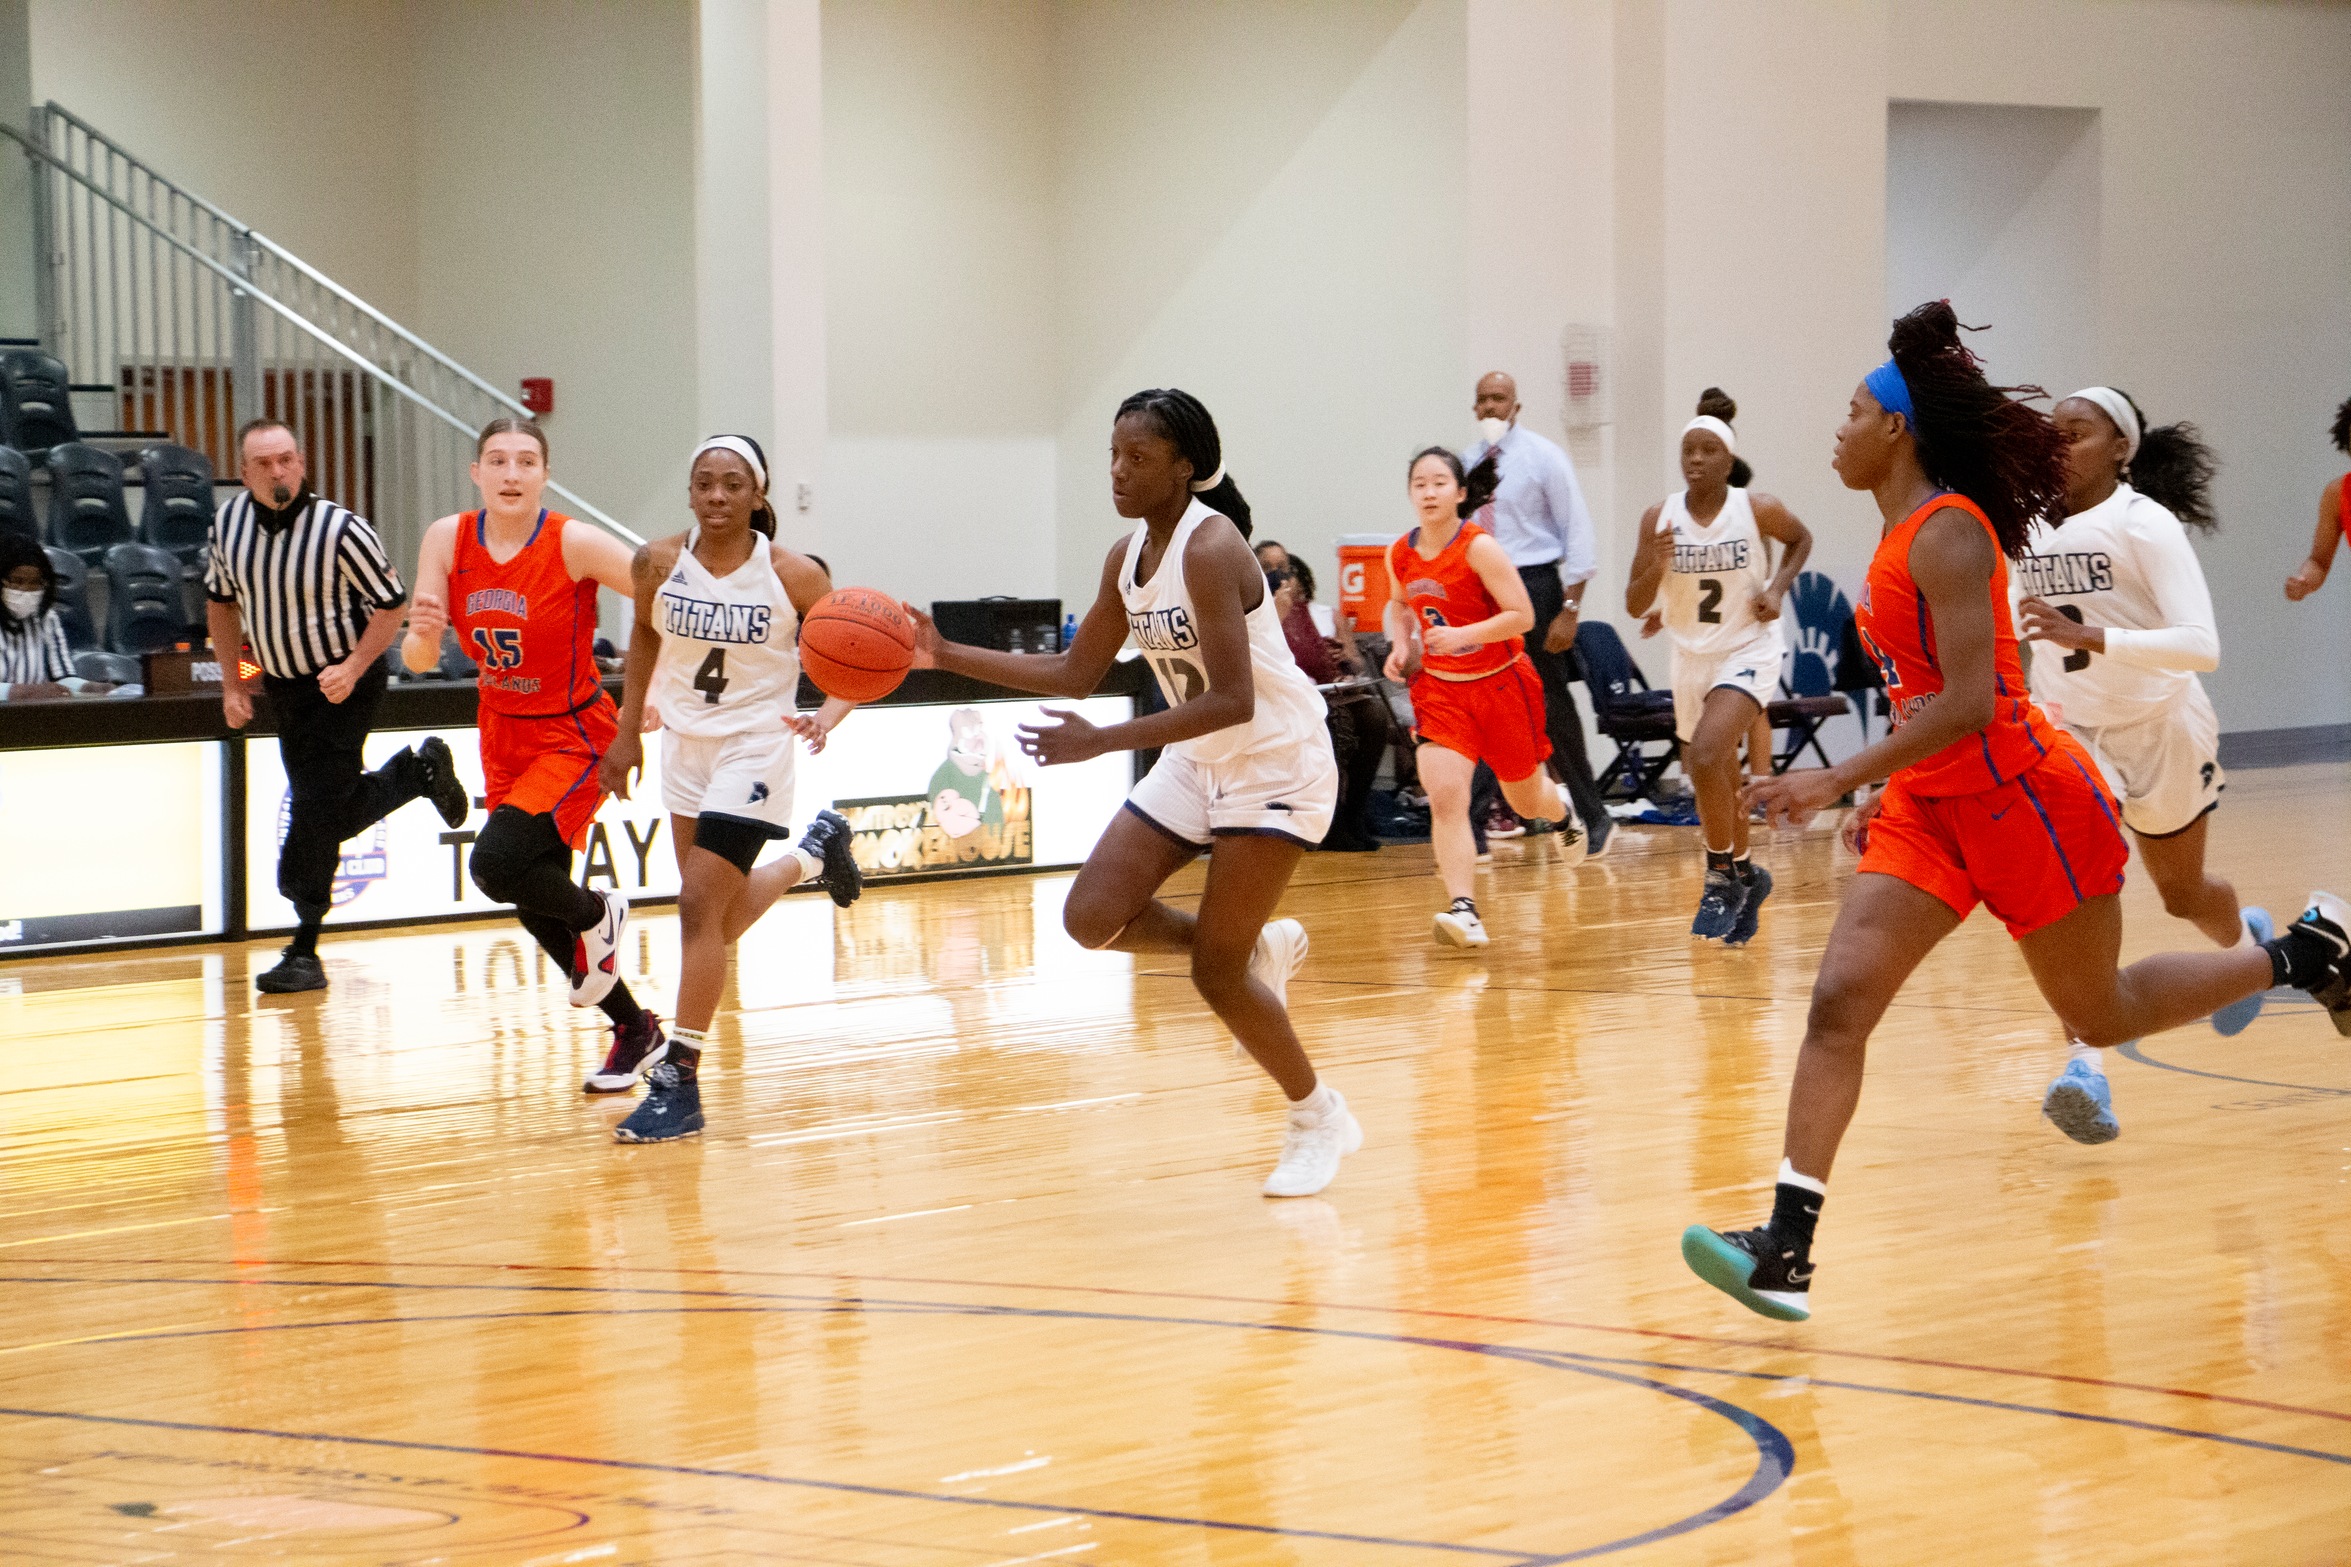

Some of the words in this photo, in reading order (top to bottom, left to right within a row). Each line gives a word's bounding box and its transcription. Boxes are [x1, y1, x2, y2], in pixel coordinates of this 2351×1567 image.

[1342, 562, 1365, 594] G
[465, 588, 528, 621] GEORGIA
[661, 592, 771, 644] TITANS
[1699, 579, 1723, 624] 2
[471, 627, 523, 672] 15
[693, 647, 730, 704] 4
[438, 817, 662, 902] TAY
